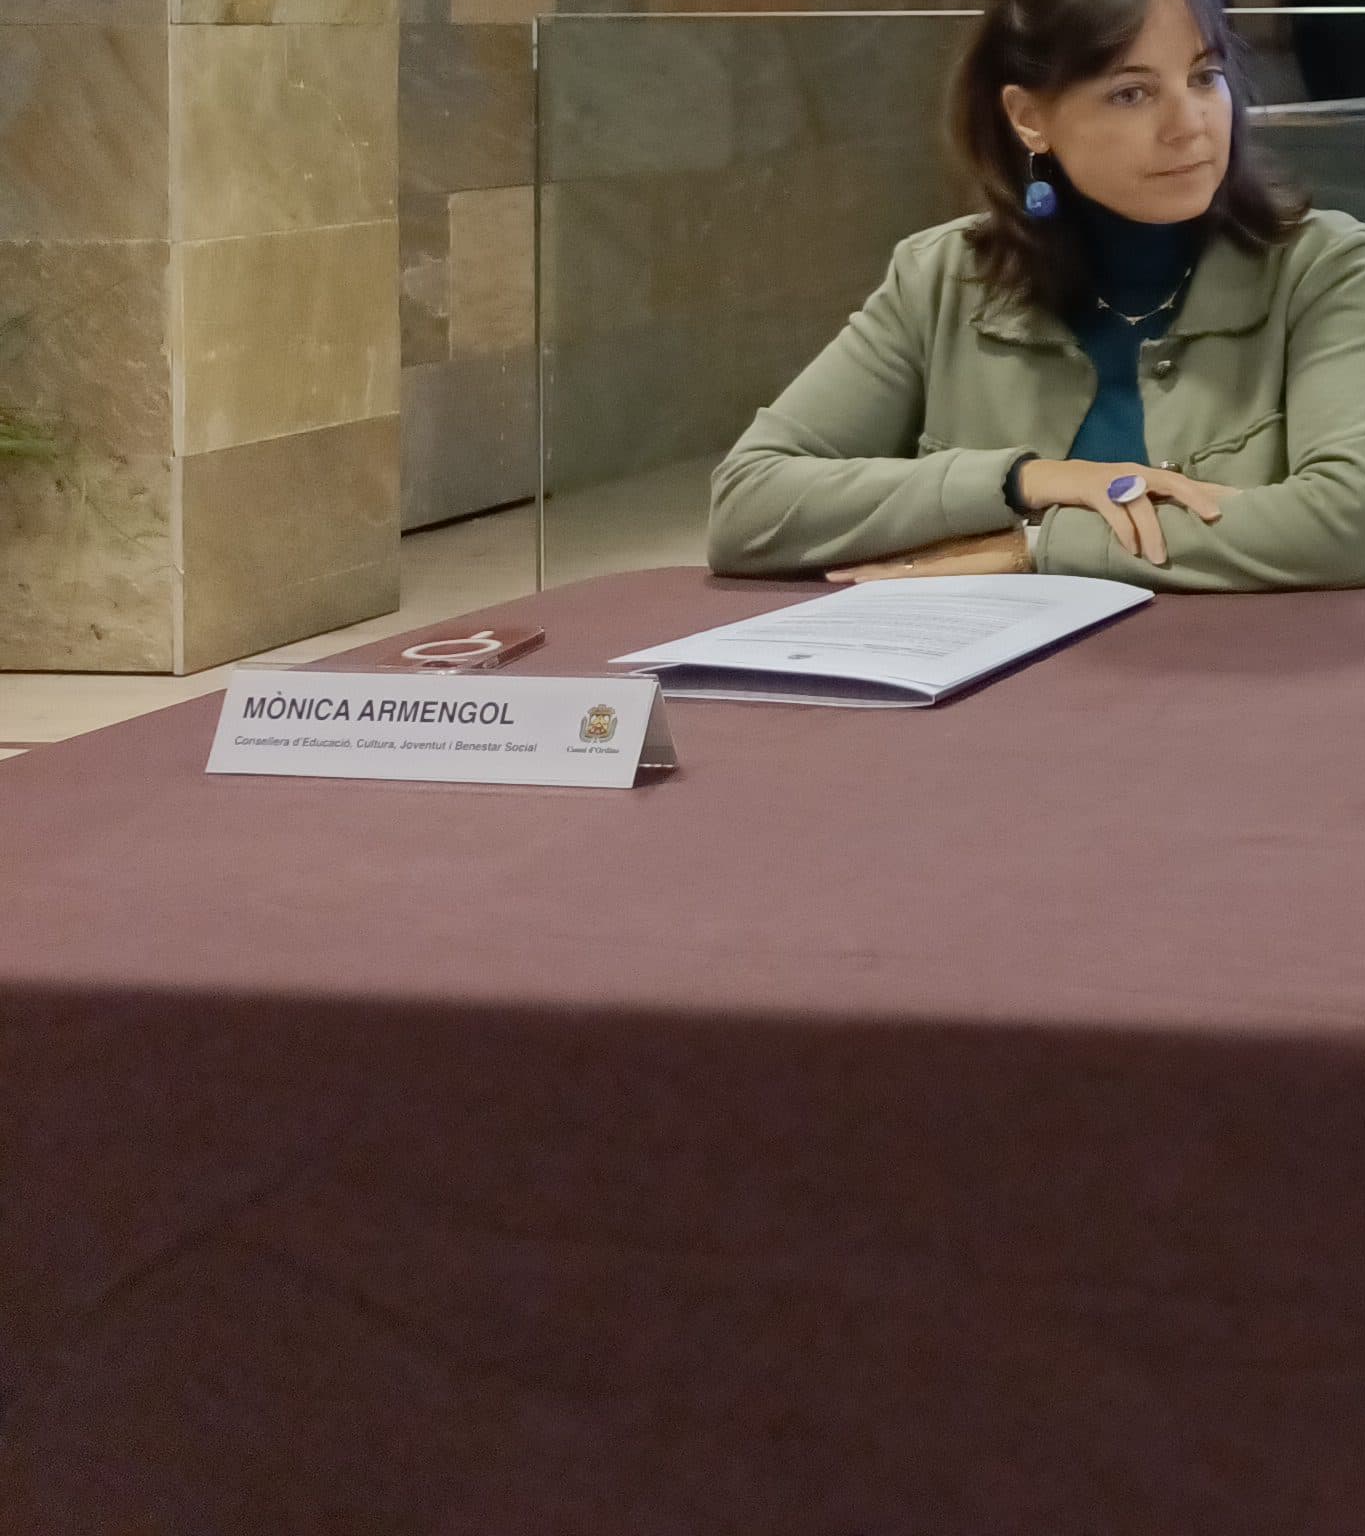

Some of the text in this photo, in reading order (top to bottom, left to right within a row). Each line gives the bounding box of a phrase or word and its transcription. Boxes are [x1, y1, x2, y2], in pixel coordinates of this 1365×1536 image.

[242, 691, 515, 726] MÒNICA ARMENGOL
[234, 735, 290, 747] Consellera
[356, 738, 397, 750] Cultura,
[400, 740, 446, 750] Joventut
[455, 740, 502, 752] Benestar
[504, 741, 537, 753] Social
